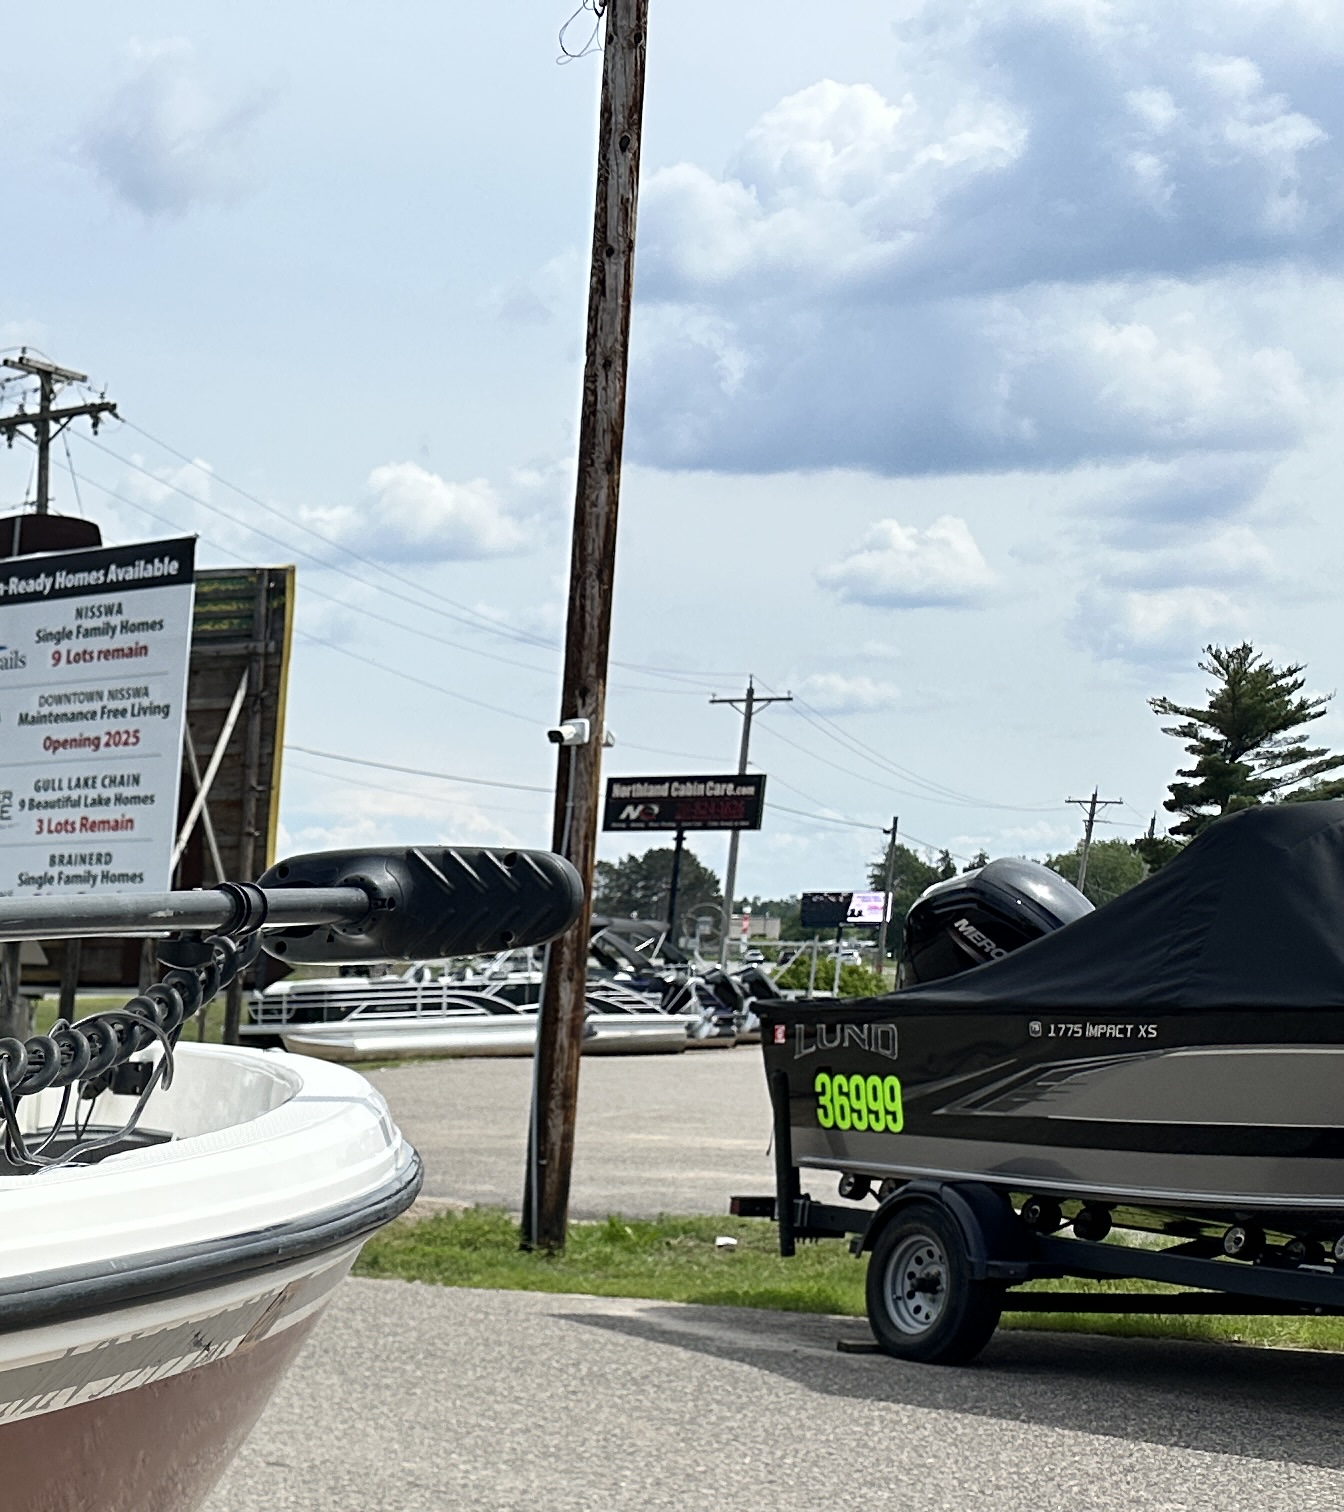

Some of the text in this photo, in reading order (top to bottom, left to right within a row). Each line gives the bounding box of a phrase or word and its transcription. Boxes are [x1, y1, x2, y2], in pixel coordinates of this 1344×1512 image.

[55, 568, 105, 589] Homes
[107, 556, 179, 583] Available
[74, 602, 123, 621] NISSWA
[35, 617, 164, 646] Single Family Homes
[51, 642, 148, 667] 9 Lots remain
[38, 685, 150, 708] DOWNTOWN NISSWA
[18, 700, 171, 727] Maintenance Free Living
[43, 729, 141, 755] Opening 2025
[34, 773, 141, 793] GULL LAKE CHAIN
[612, 782, 669, 798] Northland
[670, 781, 705, 797] Cabin
[18, 792, 155, 812] 9 Beautiful Lake Homes
[35, 818, 44, 835] 3
[47, 817, 76, 835] Lots
[79, 813, 135, 834] Remain
[48, 851, 113, 868] BRAINERD
[17, 869, 144, 890] Single Family Homes
[953, 918, 1009, 961] MERC
[1048, 1021, 1158, 1038] 1775 IMPACT XS
[793, 1023, 899, 1061] LUND
[814, 1072, 904, 1134] 36999
